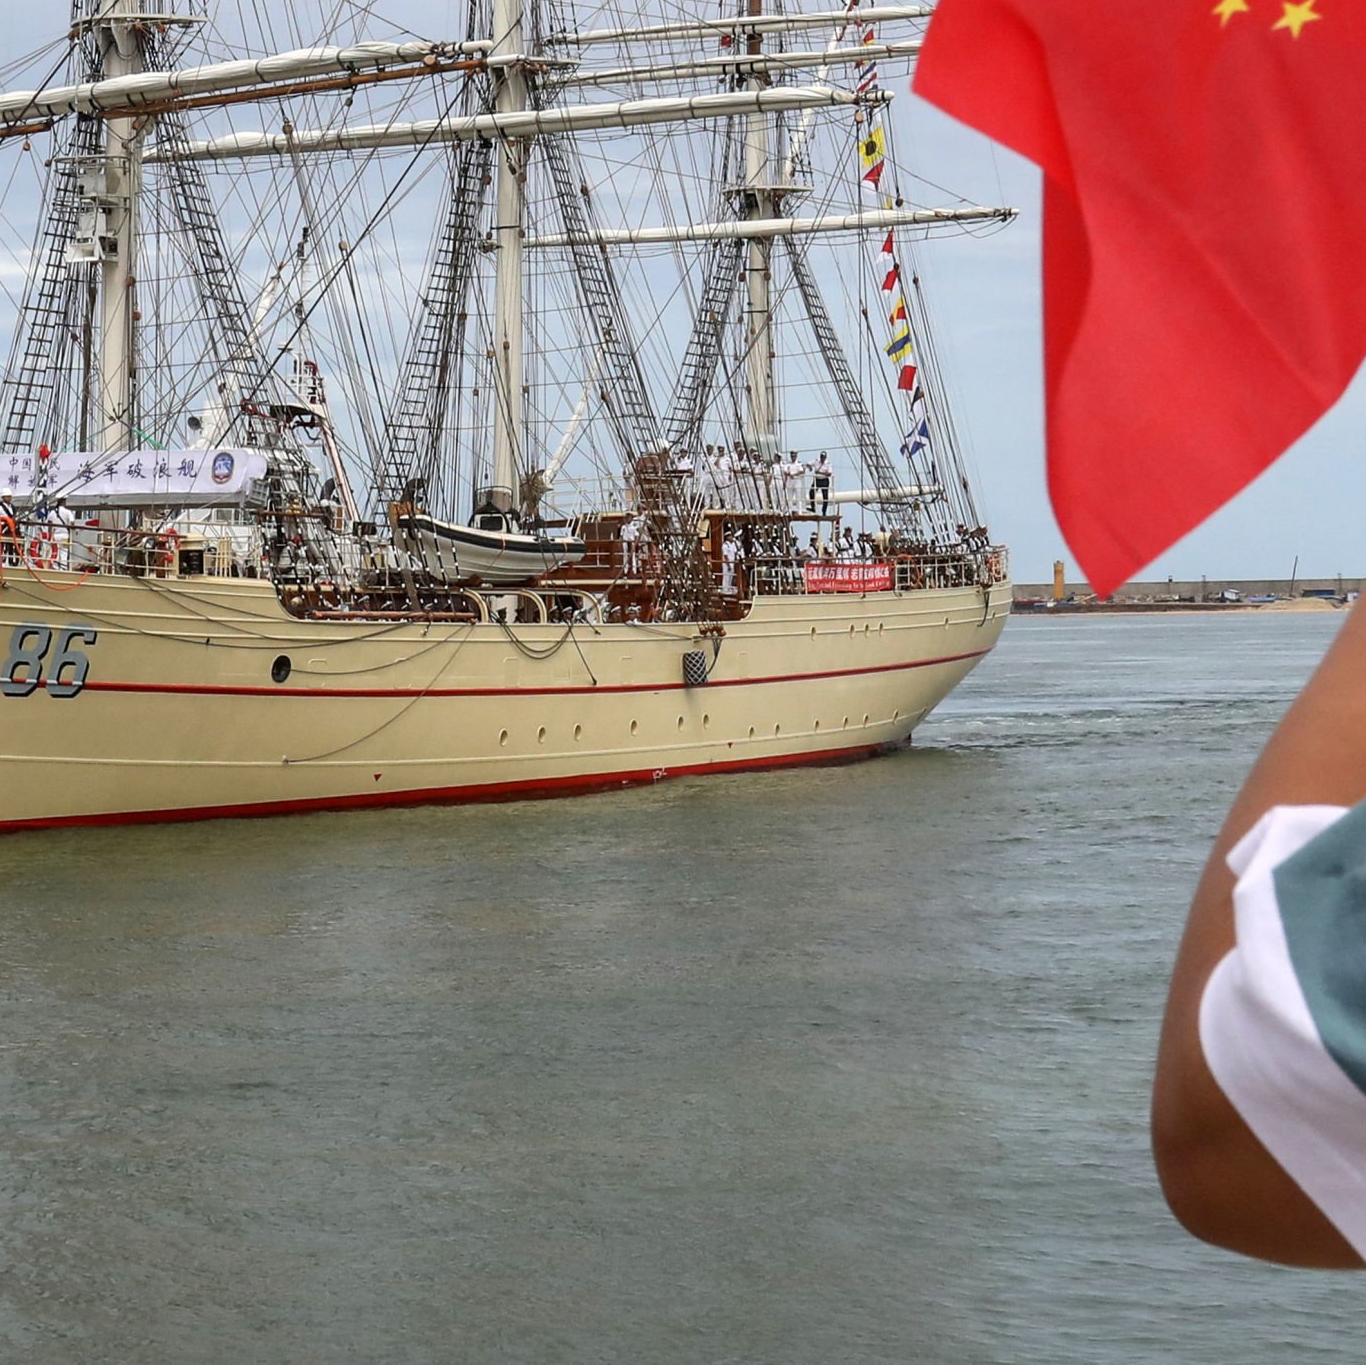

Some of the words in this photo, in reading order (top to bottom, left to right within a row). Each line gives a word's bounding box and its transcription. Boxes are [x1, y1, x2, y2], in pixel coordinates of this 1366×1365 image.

[9, 456, 60, 472] 中国民
[0, 621, 97, 698] 86
